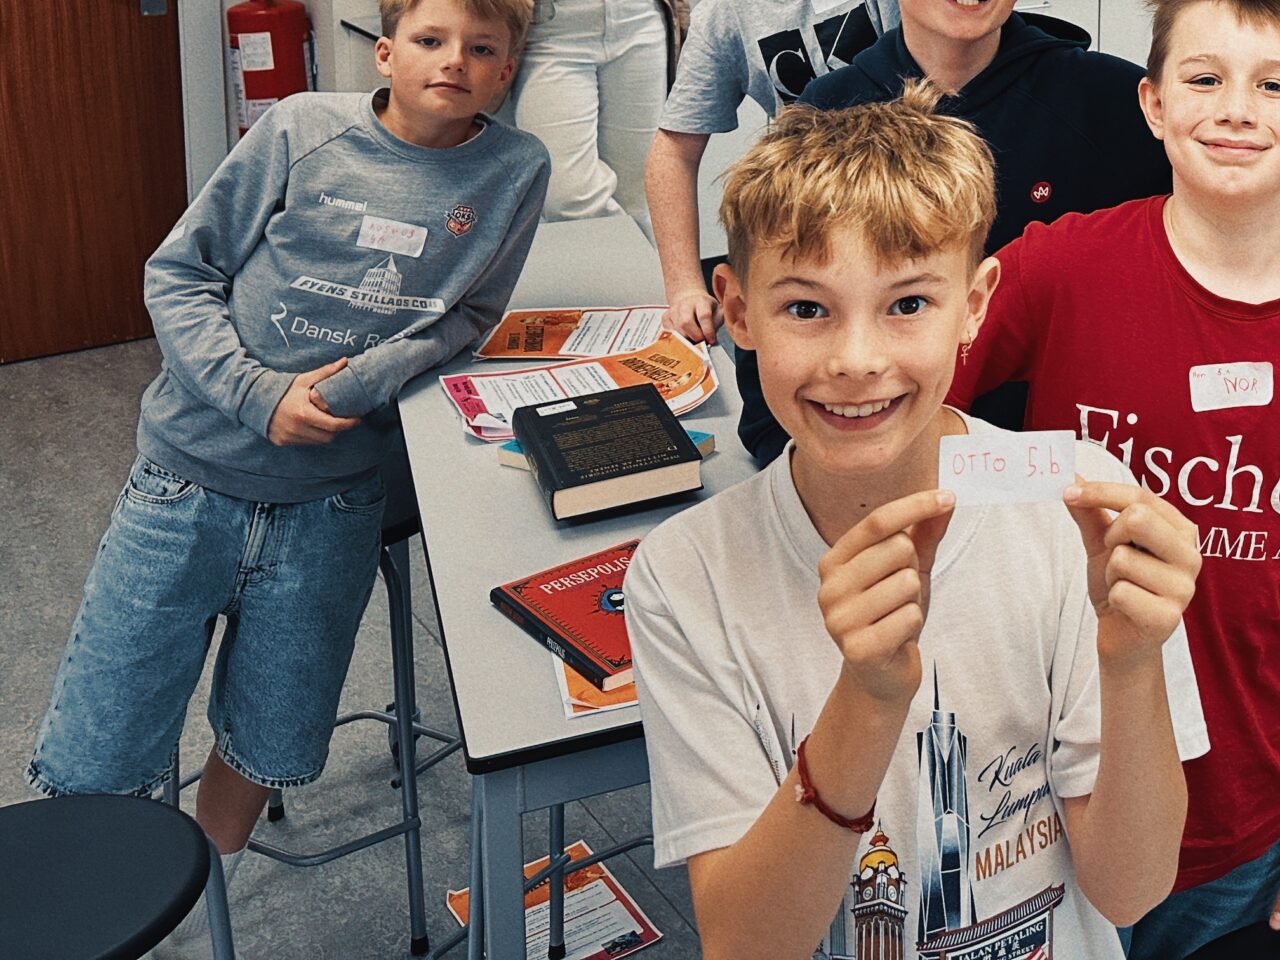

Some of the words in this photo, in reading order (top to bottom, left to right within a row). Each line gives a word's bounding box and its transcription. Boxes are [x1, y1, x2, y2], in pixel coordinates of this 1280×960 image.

[319, 191, 368, 211] hummel
[299, 279, 348, 296] FYENS
[350, 291, 409, 307] STILLADS
[291, 316, 357, 347] Dansk
[1195, 526, 1268, 561] MME
[539, 556, 631, 595] PERSEPOLIS
[978, 742, 1043, 792] Kuala
[975, 811, 1063, 881] MALAYSIA
[994, 922, 1044, 951] PETALING
